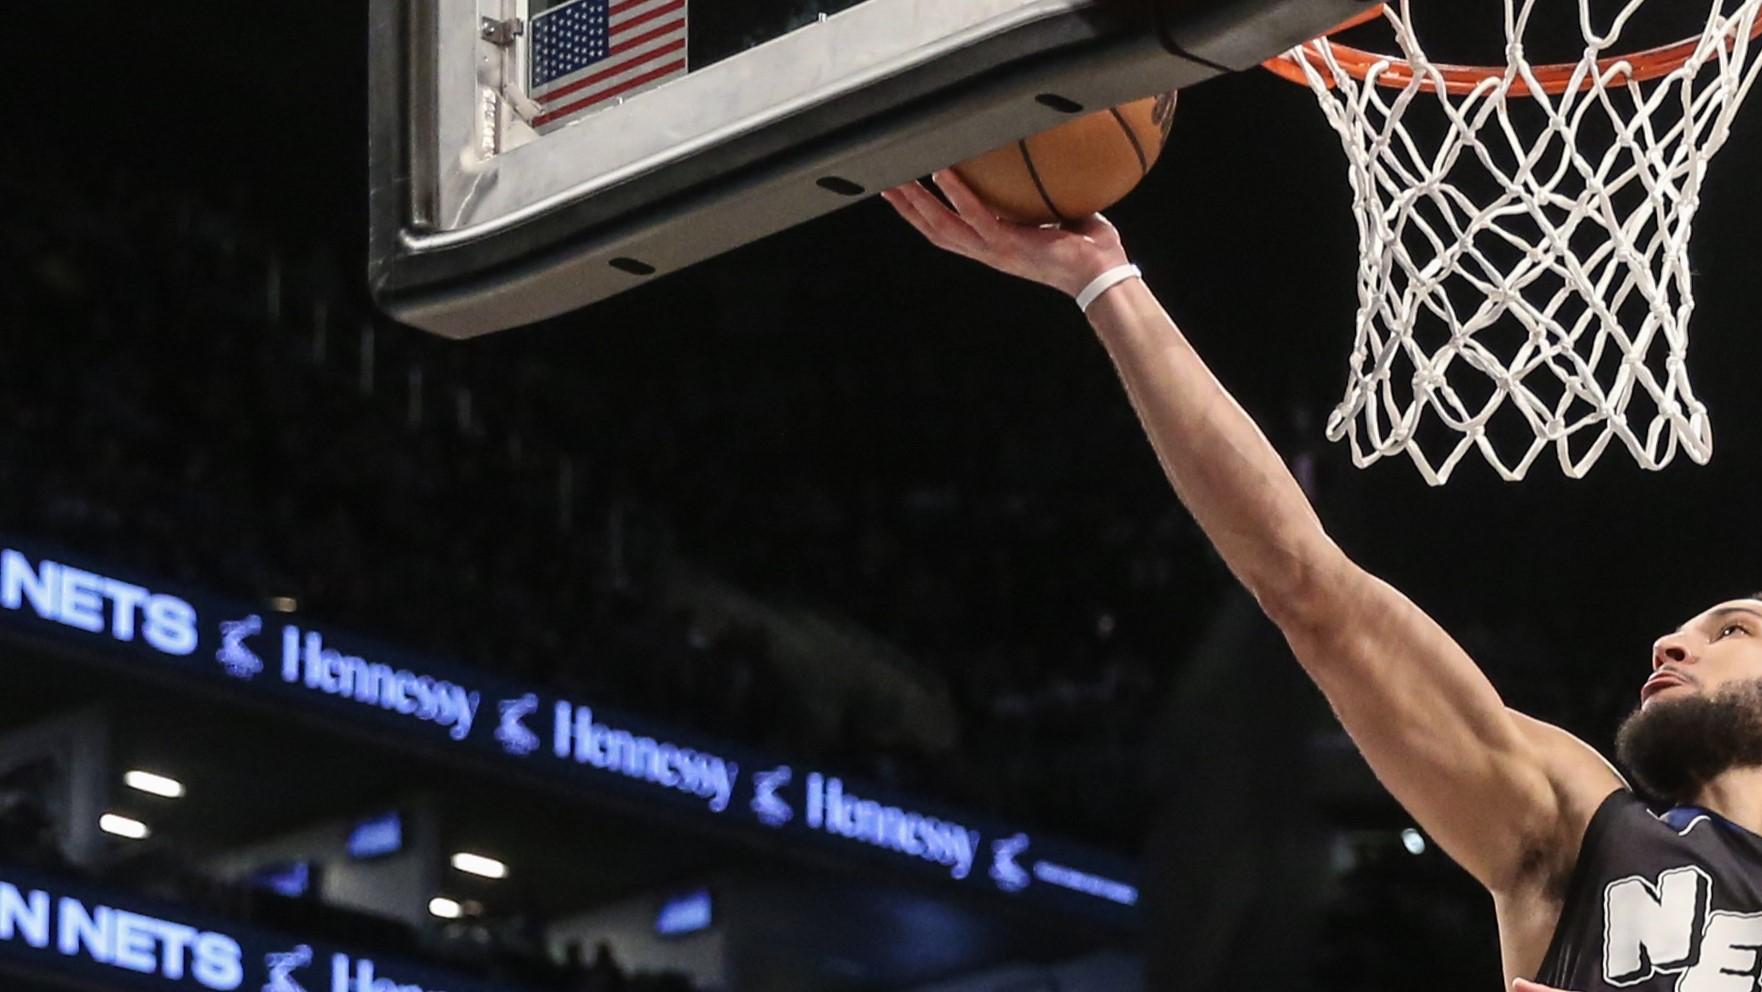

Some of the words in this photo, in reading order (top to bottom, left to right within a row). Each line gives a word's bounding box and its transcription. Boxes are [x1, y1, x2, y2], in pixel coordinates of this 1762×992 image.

[0, 549, 198, 656] NETS
[281, 625, 480, 740] Hennessy
[553, 700, 738, 812] Hennessy
[806, 771, 979, 879] Hennessy
[57, 896, 243, 990] NETS
